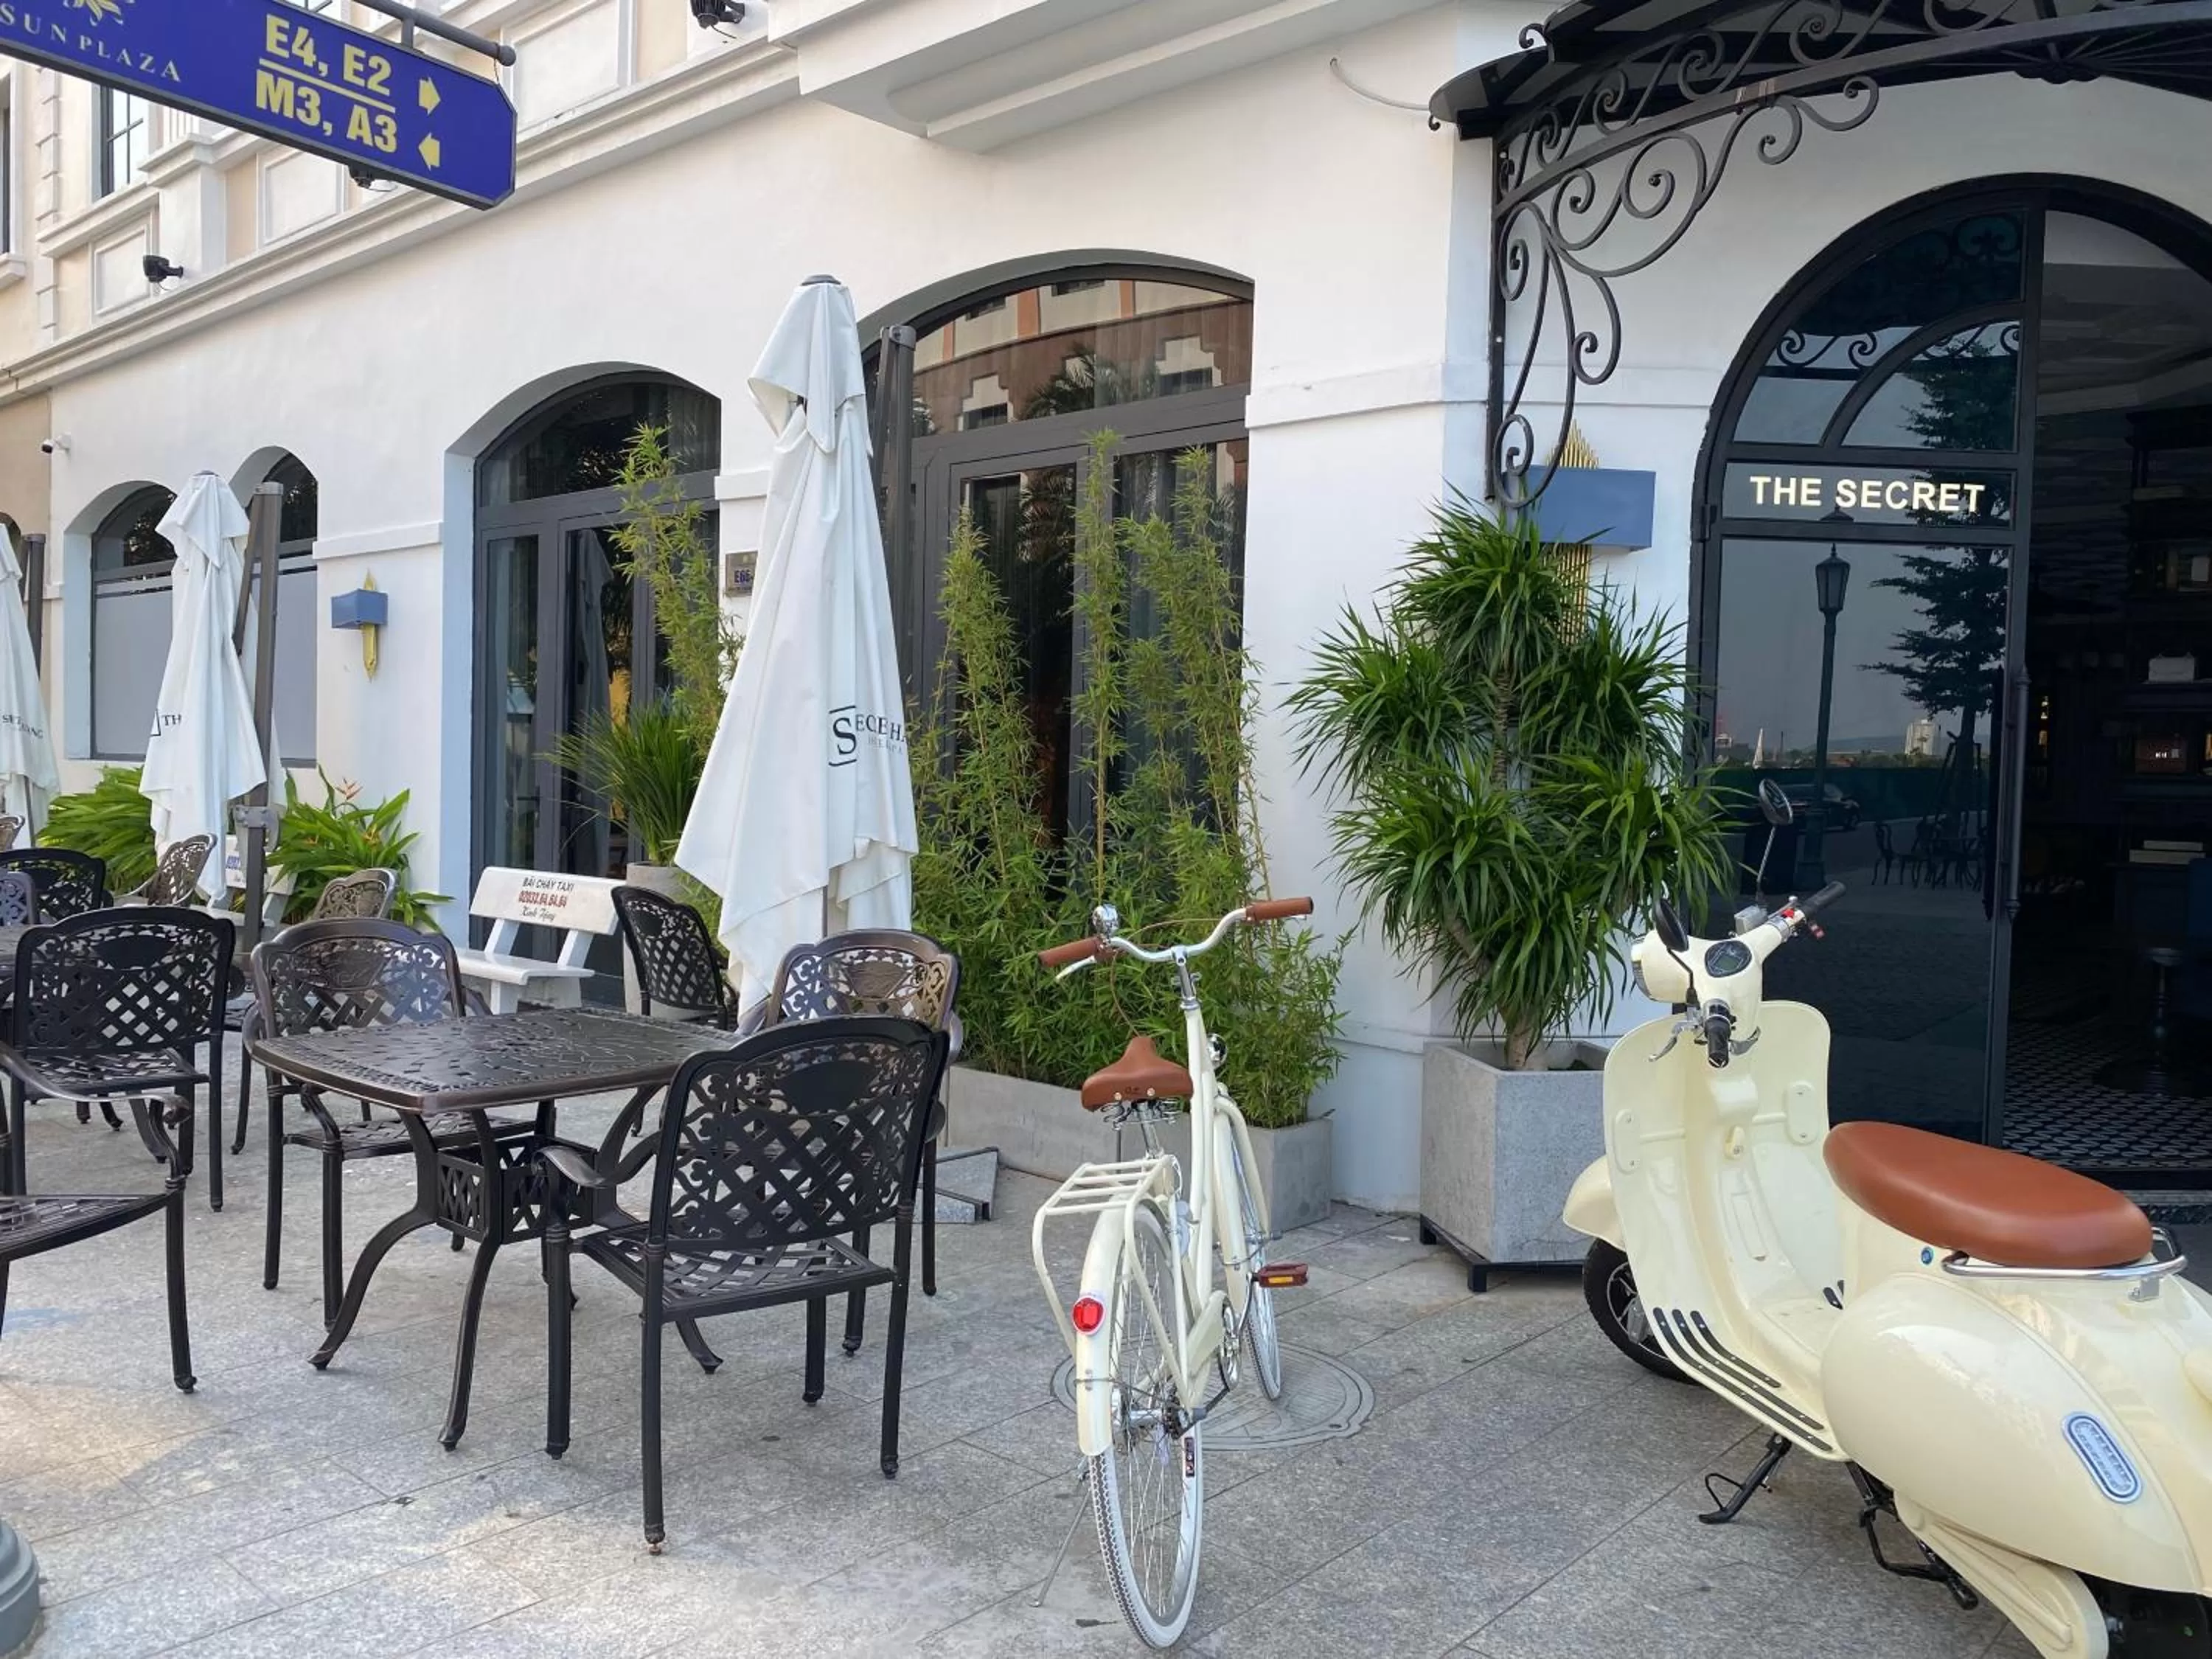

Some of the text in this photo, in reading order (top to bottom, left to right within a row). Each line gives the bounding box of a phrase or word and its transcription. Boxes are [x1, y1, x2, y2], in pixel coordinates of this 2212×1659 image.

[0, 3, 181, 83] SUN PLAZA
[266, 13, 392, 97] E4, E2
[256, 69, 397, 153] M3, A3
[1750, 476, 1986, 512] THE SECRET
[557, 881, 574, 891] TAXI
